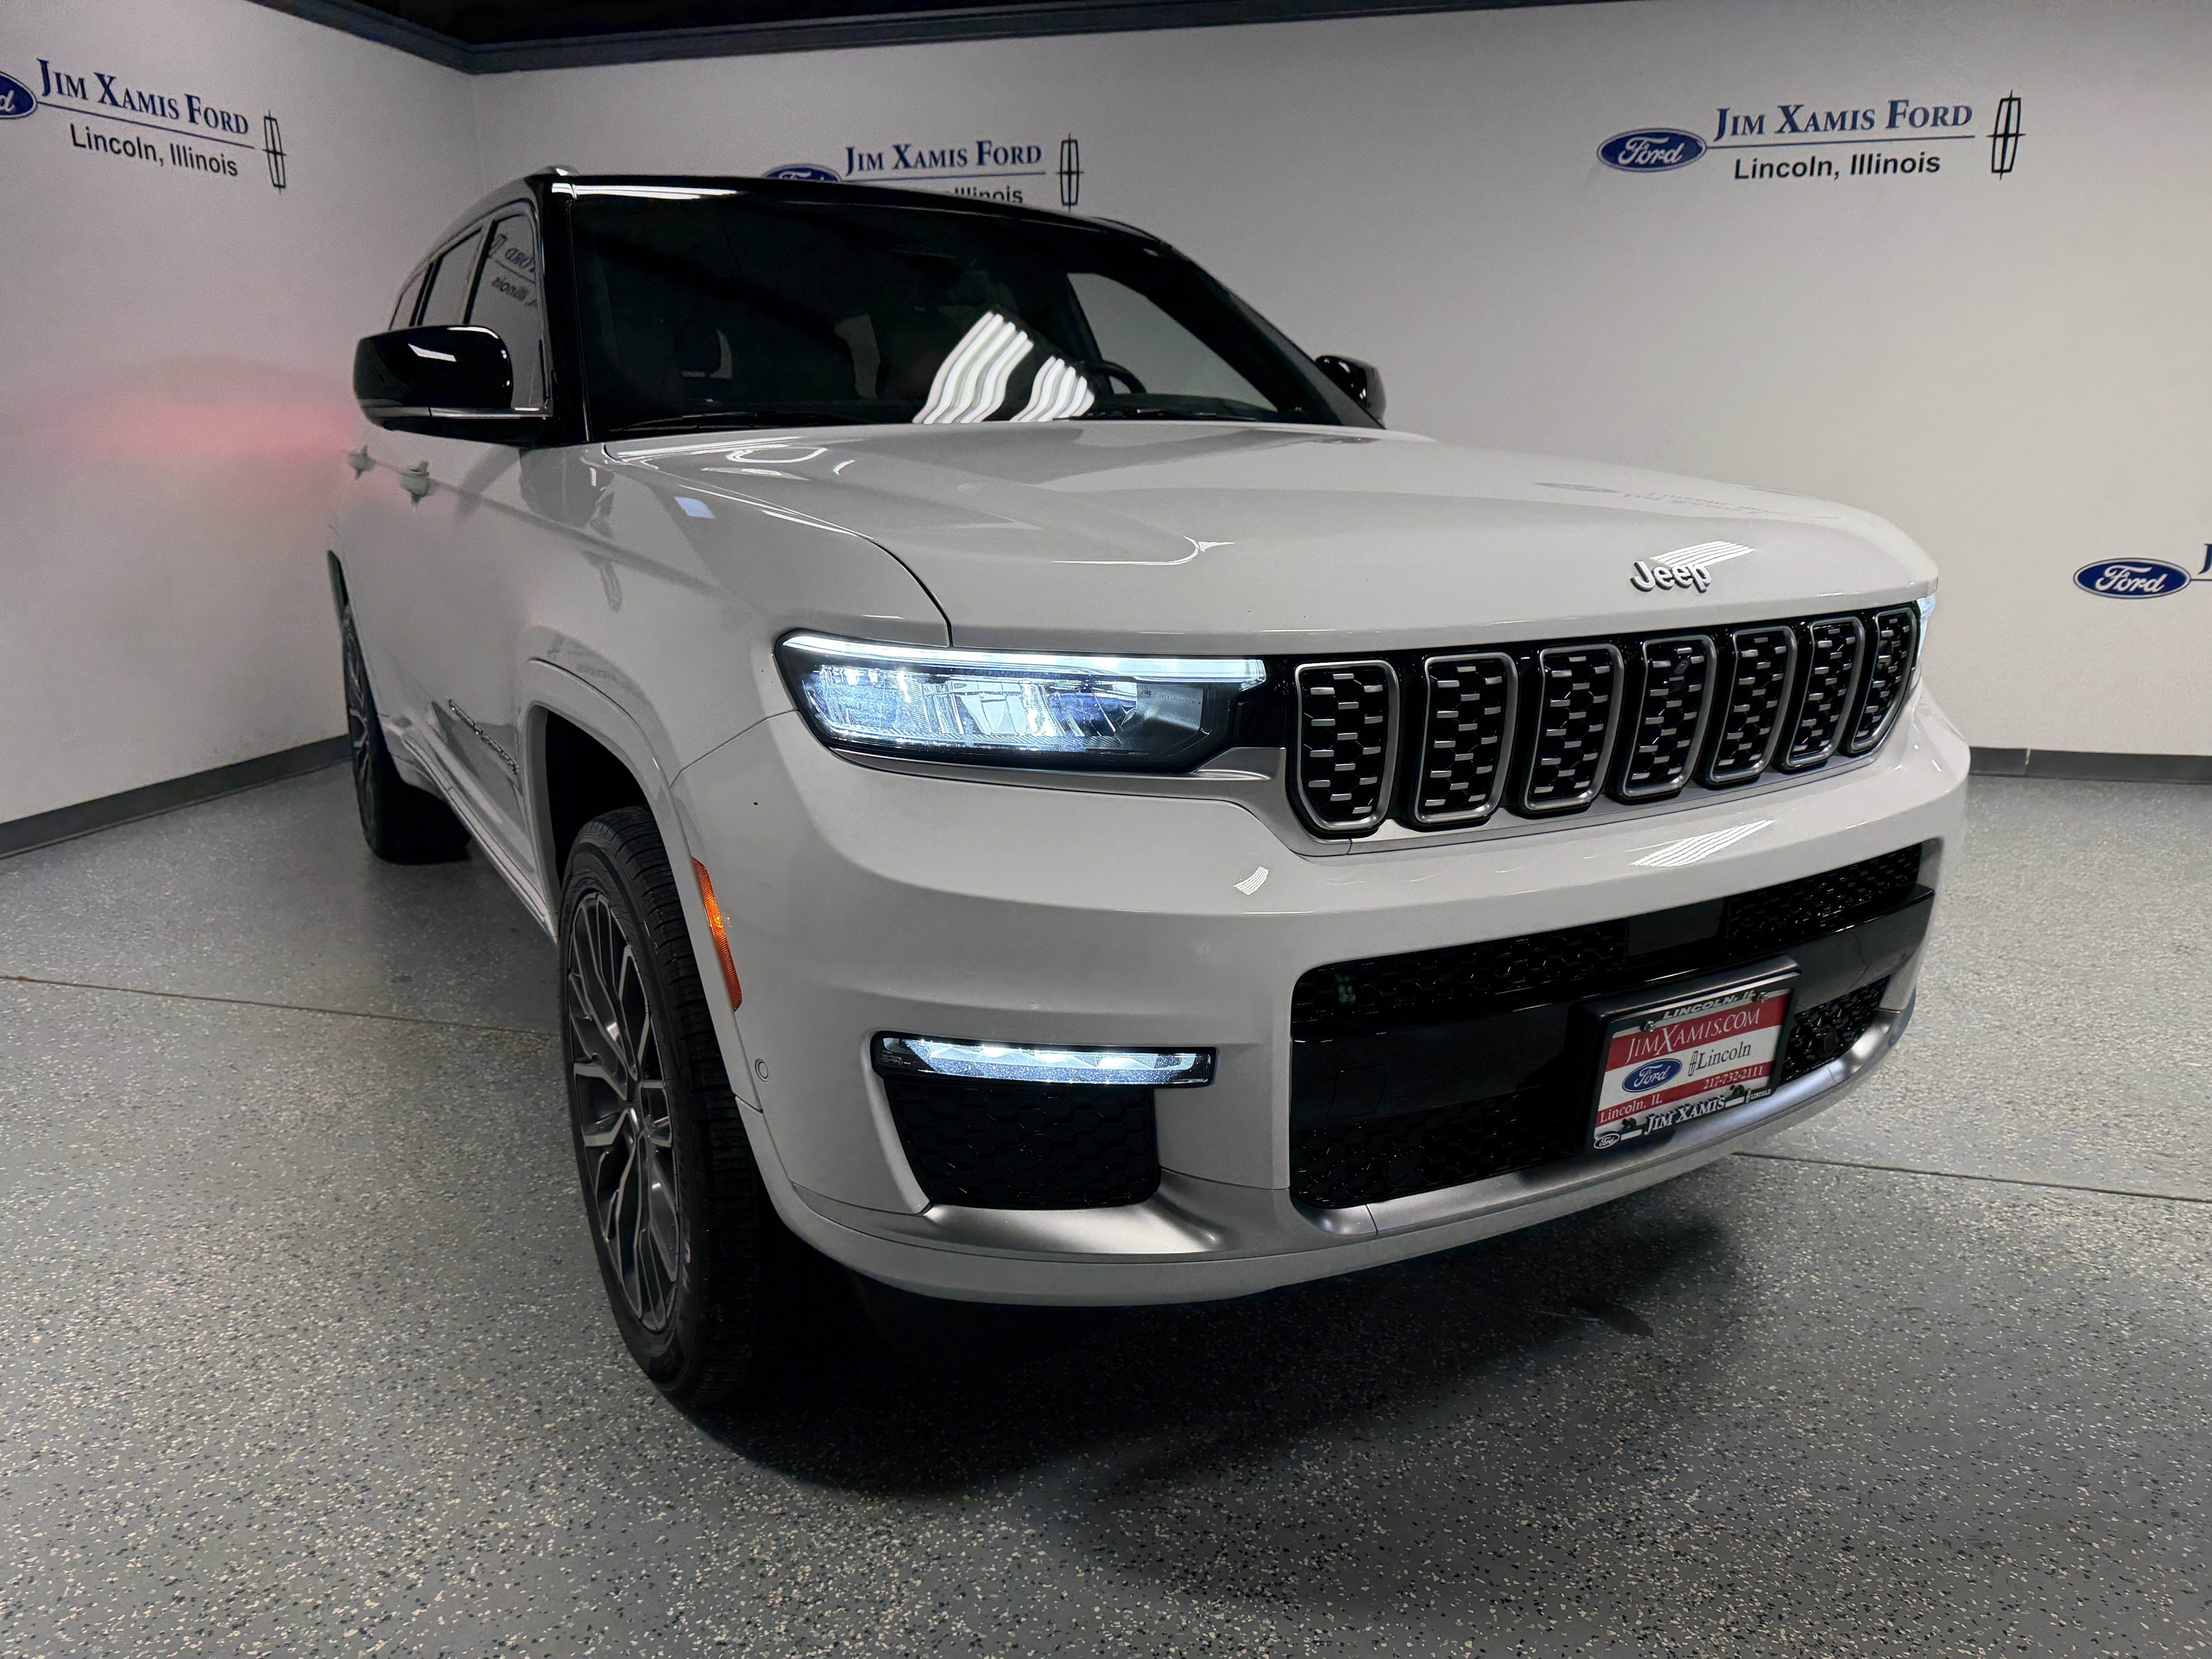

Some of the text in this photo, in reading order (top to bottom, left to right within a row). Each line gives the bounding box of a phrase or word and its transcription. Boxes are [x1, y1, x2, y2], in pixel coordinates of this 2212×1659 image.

[37, 58, 249, 134] JIM XAMIS FORD
[1714, 100, 1972, 141] JIM XAMIS FORD
[70, 124, 238, 176] Lincoln, Illinois
[845, 147, 884, 176] JIM
[892, 143, 968, 169] XAMIS
[976, 140, 1042, 166] FORD
[1618, 136, 1685, 165] Ford
[1735, 151, 1941, 180] Lincoln, Illinois
[1630, 561, 1712, 593] Jeep
[2095, 565, 2168, 592] Ford
[1662, 995, 1738, 1020] LINCOLN,
[1625, 1008, 1760, 1064] JIMXAMIS.COM
[1695, 1041, 1752, 1070] Lincoln
[1633, 1064, 1671, 1088] Ford
[1703, 1065, 1763, 1090] 217-732-2111
[1601, 1095, 1662, 1123] Lincoln, IL
[1644, 1097, 1726, 1135] JIM XAMIS
